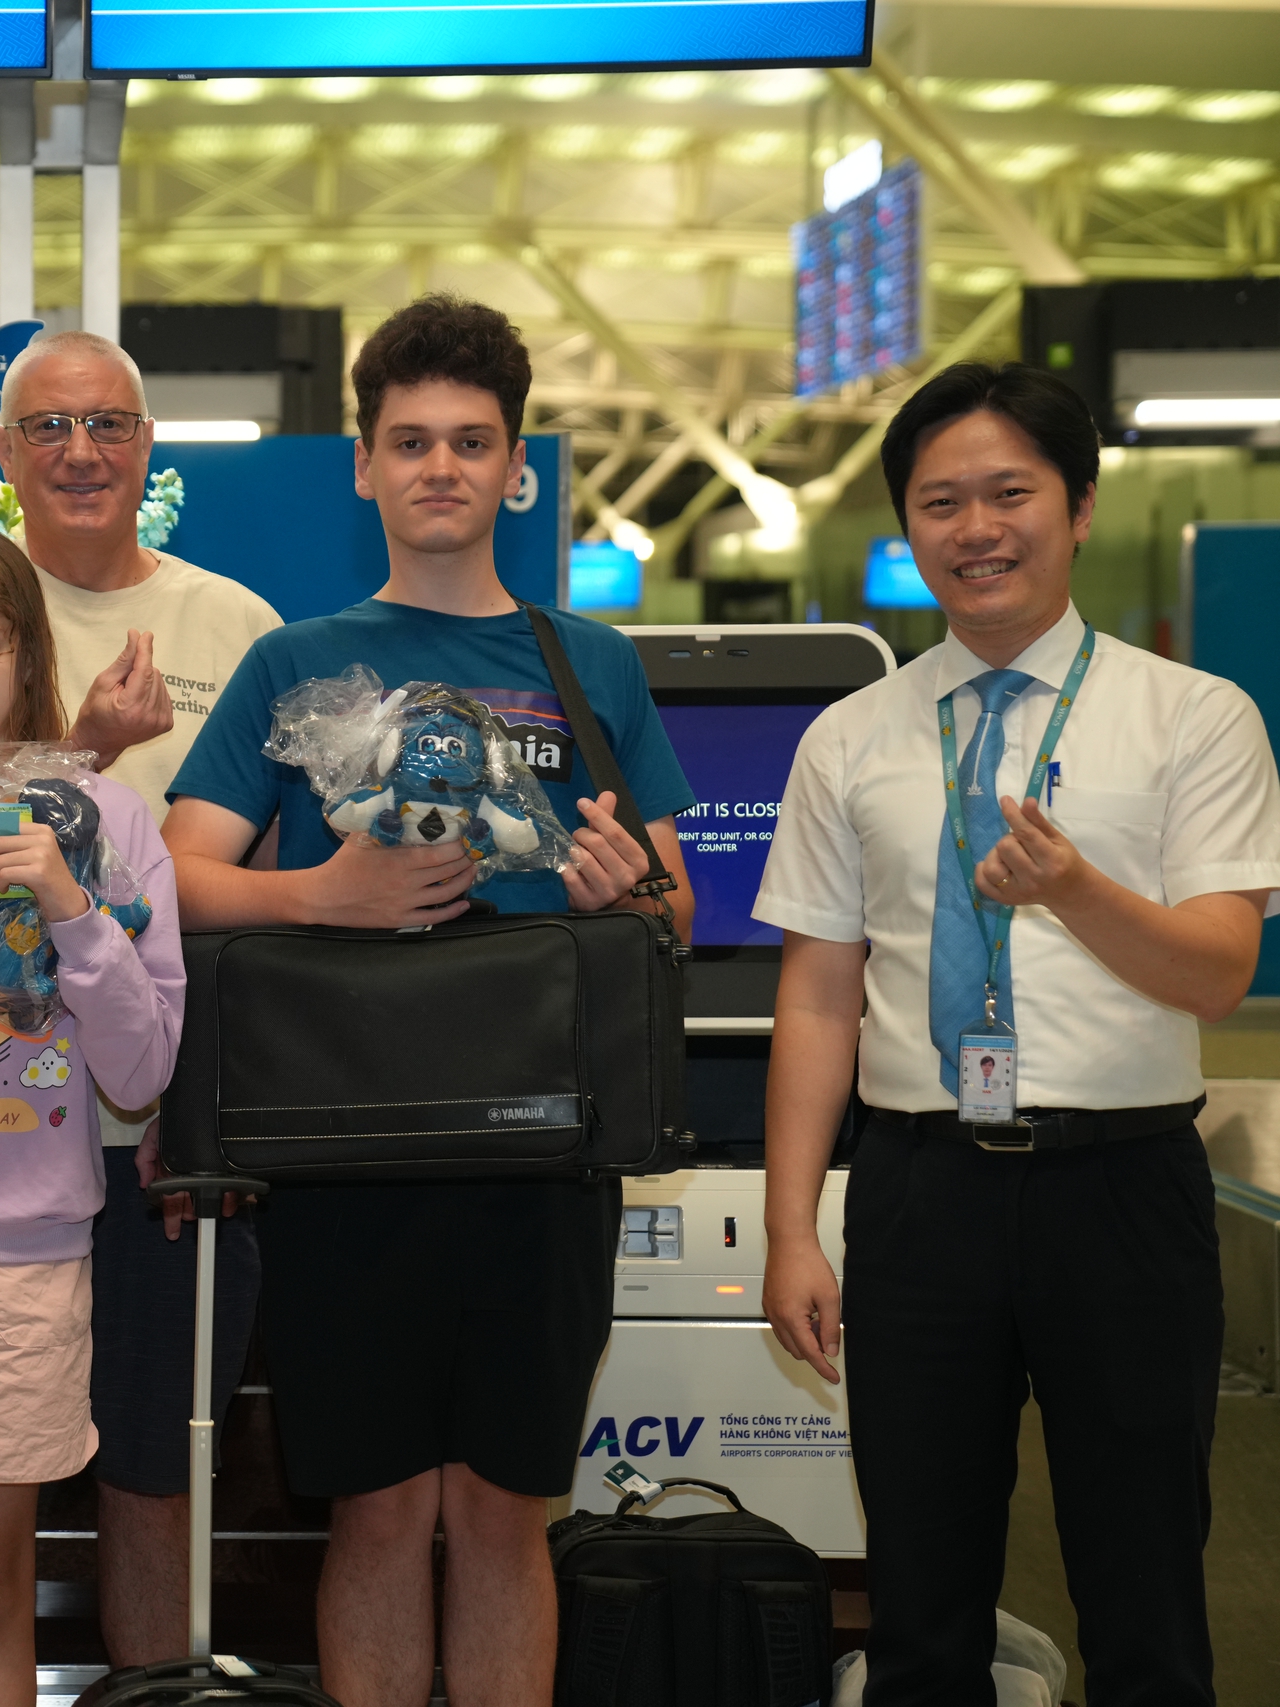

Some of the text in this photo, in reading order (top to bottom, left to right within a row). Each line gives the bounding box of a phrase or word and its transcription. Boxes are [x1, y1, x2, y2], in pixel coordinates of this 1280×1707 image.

[160, 673, 217, 693] anvas
[181, 689, 192, 699] by
[715, 803, 730, 818] IS
[677, 832, 773, 842] RENT SBD UNIT, OR GO
[696, 843, 738, 853] COUNTER
[501, 1106, 545, 1120] YAMAHA
[719, 1413, 831, 1426] TỔNG CÔNG TY CẢNG
[579, 1415, 705, 1457] ACV
[720, 1428, 751, 1439] HÀNG
[753, 1428, 791, 1439] KHÔNG
[794, 1428, 818, 1441] VIỆT
[720, 1449, 762, 1458] AIRPORTS
[764, 1449, 823, 1458] CORPORATION
[825, 1450, 837, 1458] OF
